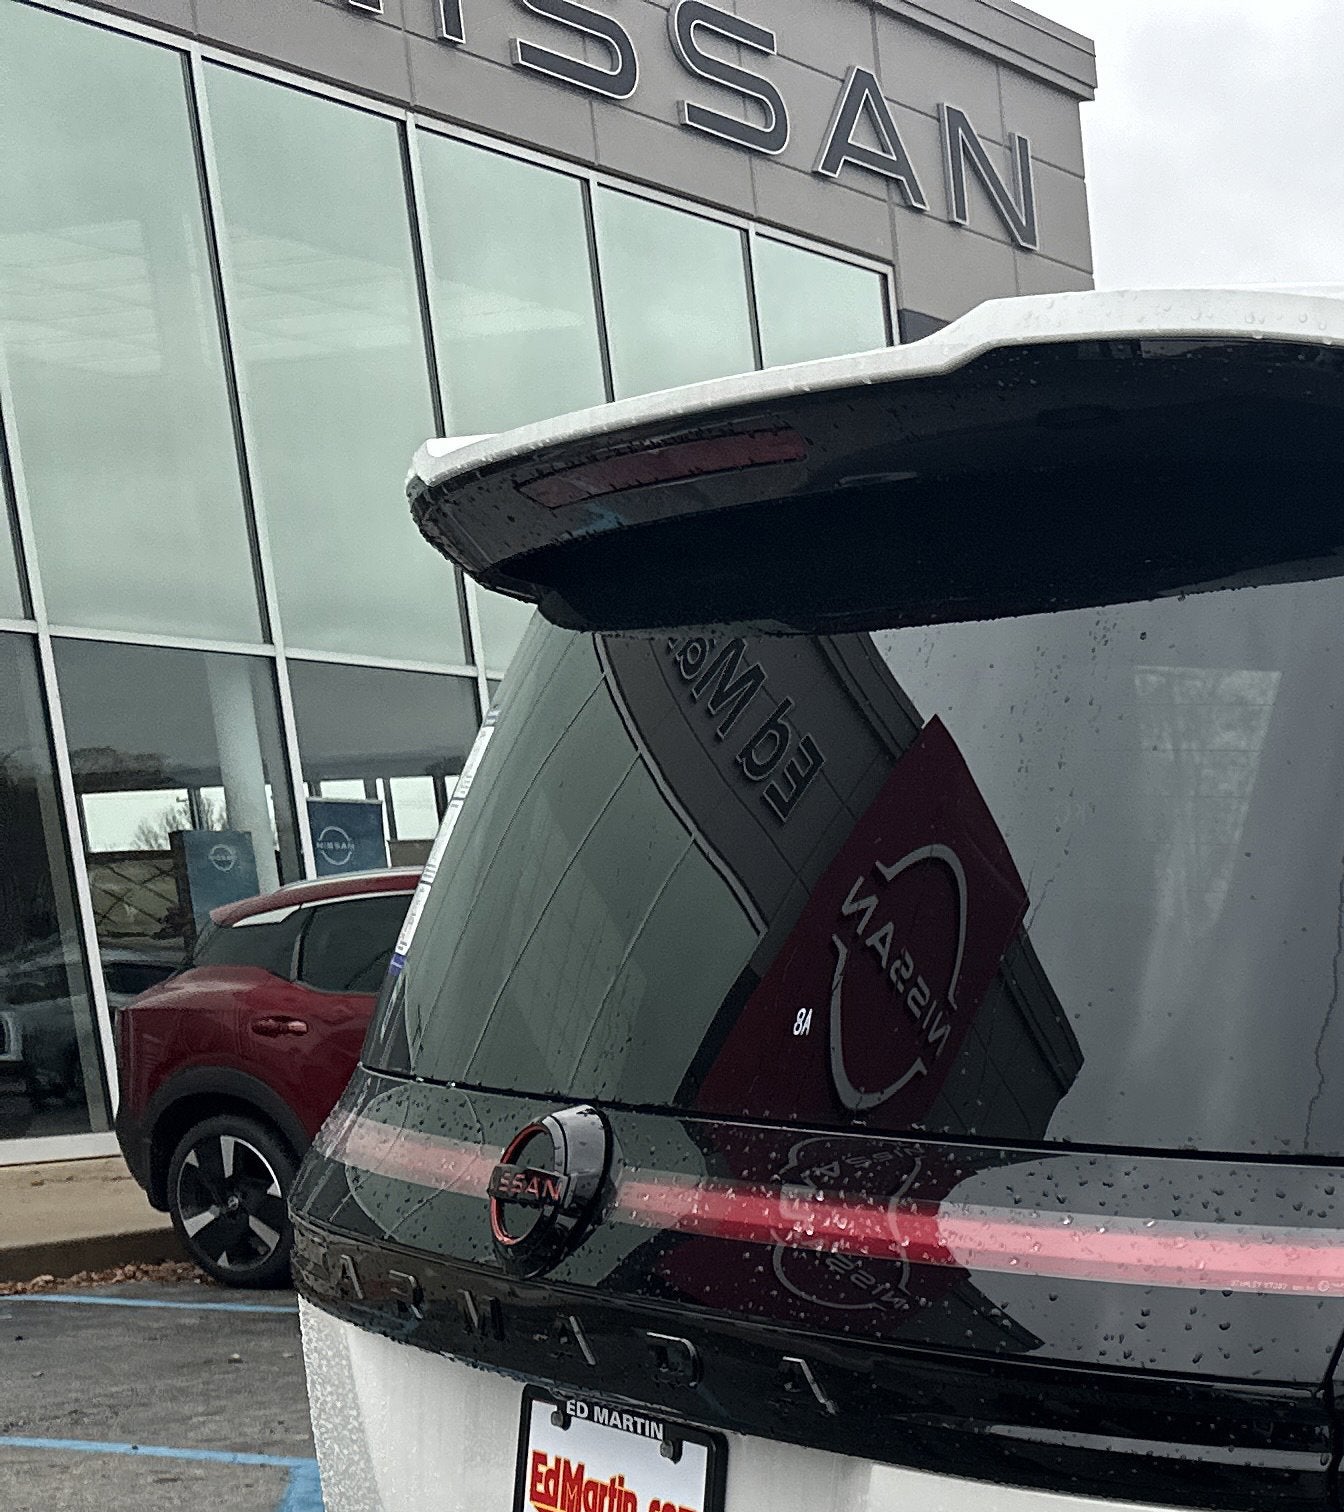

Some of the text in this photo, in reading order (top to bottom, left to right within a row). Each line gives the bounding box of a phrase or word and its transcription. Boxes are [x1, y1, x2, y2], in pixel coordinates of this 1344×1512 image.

[349, 0, 1038, 251] SSAN
[566, 1399, 664, 1440] ED MARTIN
